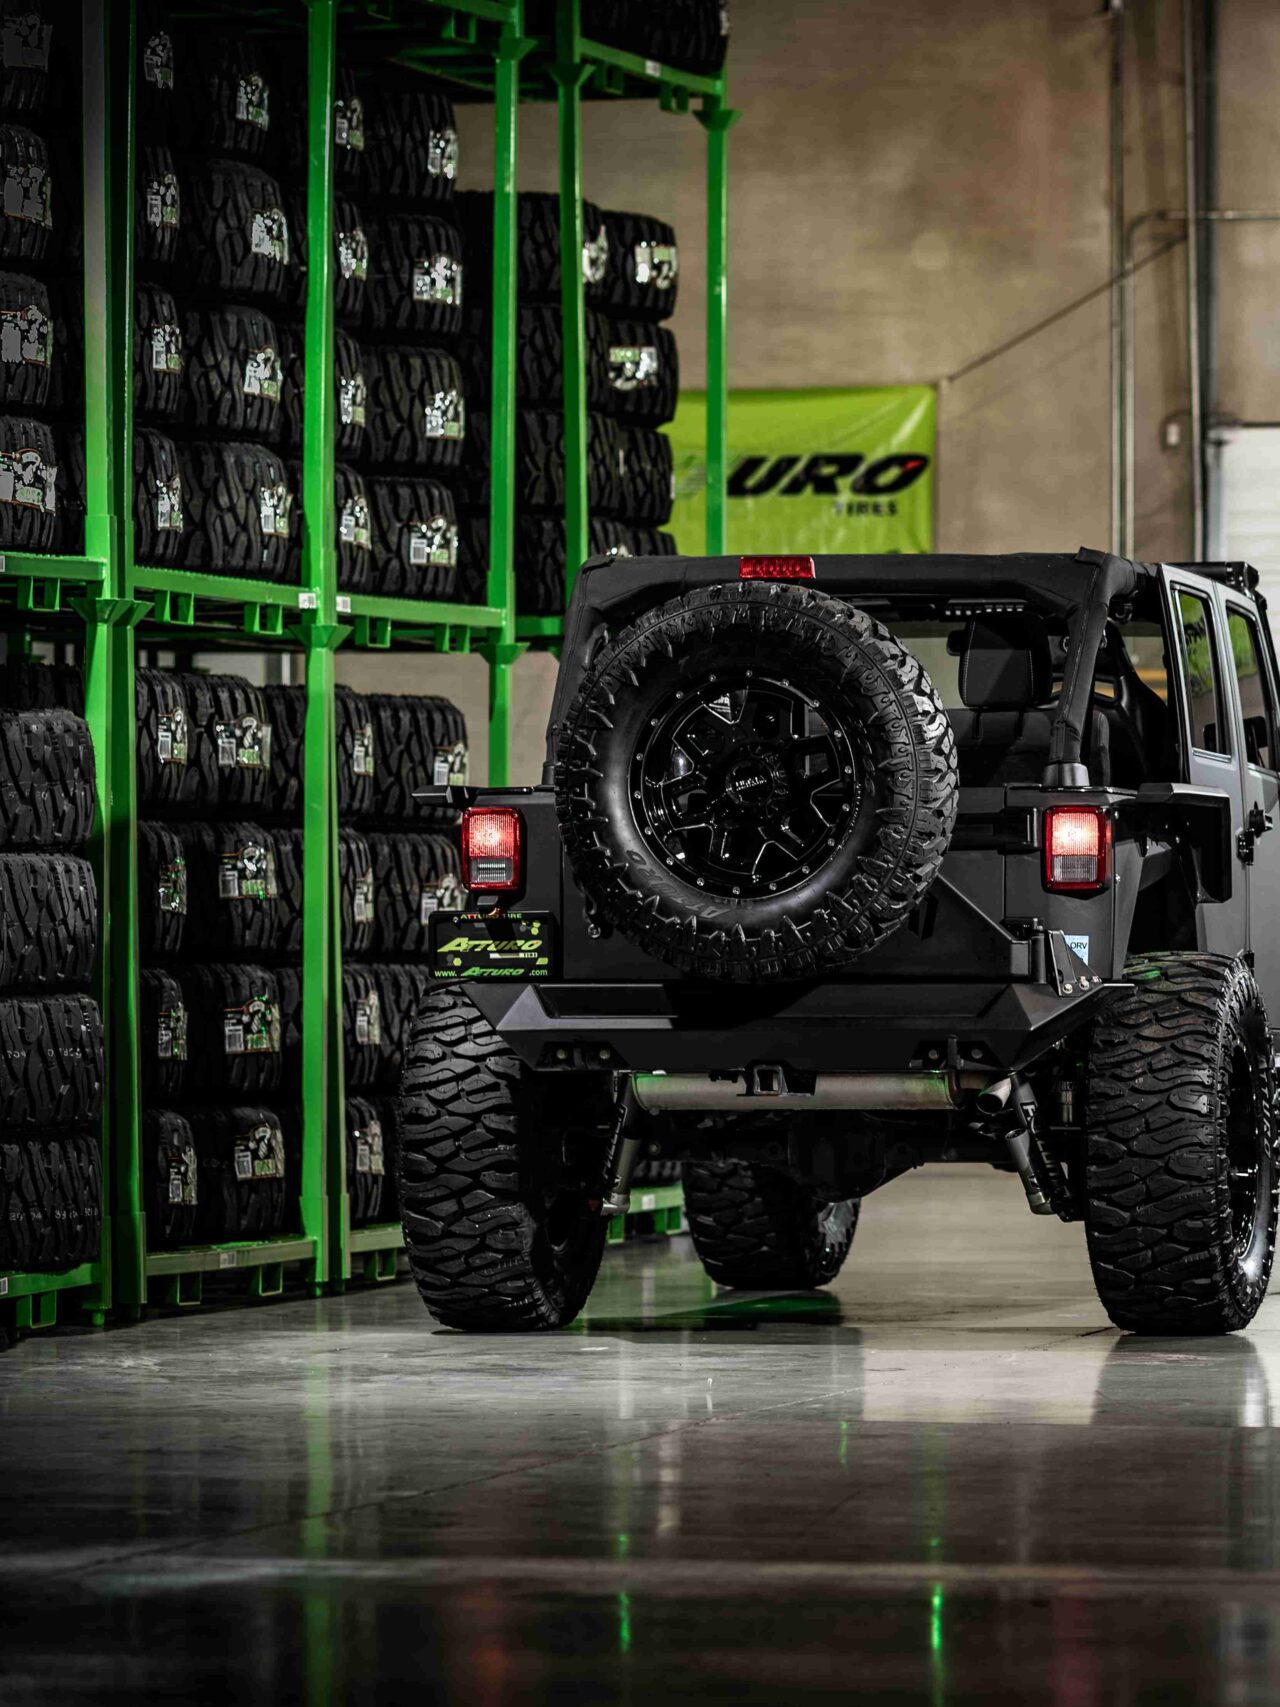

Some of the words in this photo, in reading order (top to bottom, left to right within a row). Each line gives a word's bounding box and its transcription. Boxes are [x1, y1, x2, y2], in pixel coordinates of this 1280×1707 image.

[437, 937, 542, 952] ATTURO
[1070, 941, 1088, 950] ORV
[460, 966, 525, 976] ATTURO
